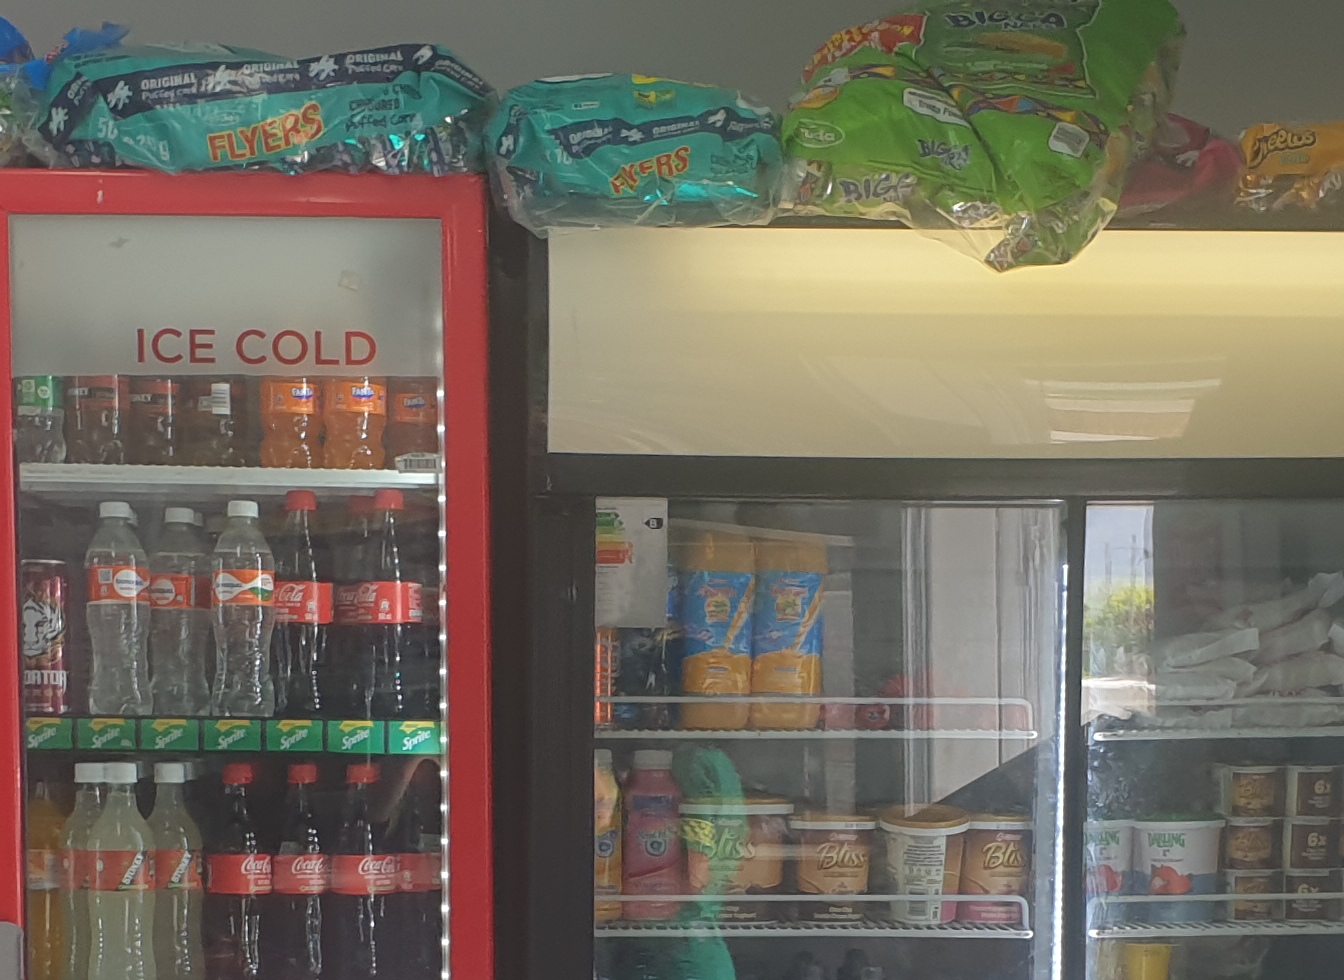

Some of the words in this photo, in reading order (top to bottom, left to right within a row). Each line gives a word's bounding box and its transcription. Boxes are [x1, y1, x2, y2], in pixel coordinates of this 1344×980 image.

[346, 51, 404, 66] ORIGINAL
[141, 71, 197, 90] ORIGINAL
[207, 101, 325, 163] FLYERS
[137, 327, 216, 364] ICE
[236, 329, 377, 366] COLD
[27, 726, 57, 749] Sprite
[91, 727, 121, 750] Sprite
[155, 727, 184, 750] Sprite
[218, 728, 246, 750] Sprite
[280, 728, 309, 751] Sprite
[342, 729, 371, 751] Sprite
[402, 730, 432, 752] Sprite
[1308, 832, 1327, 847] 6x
[817, 842, 866, 870] Bliss
[121, 852, 144, 885] STONEY
